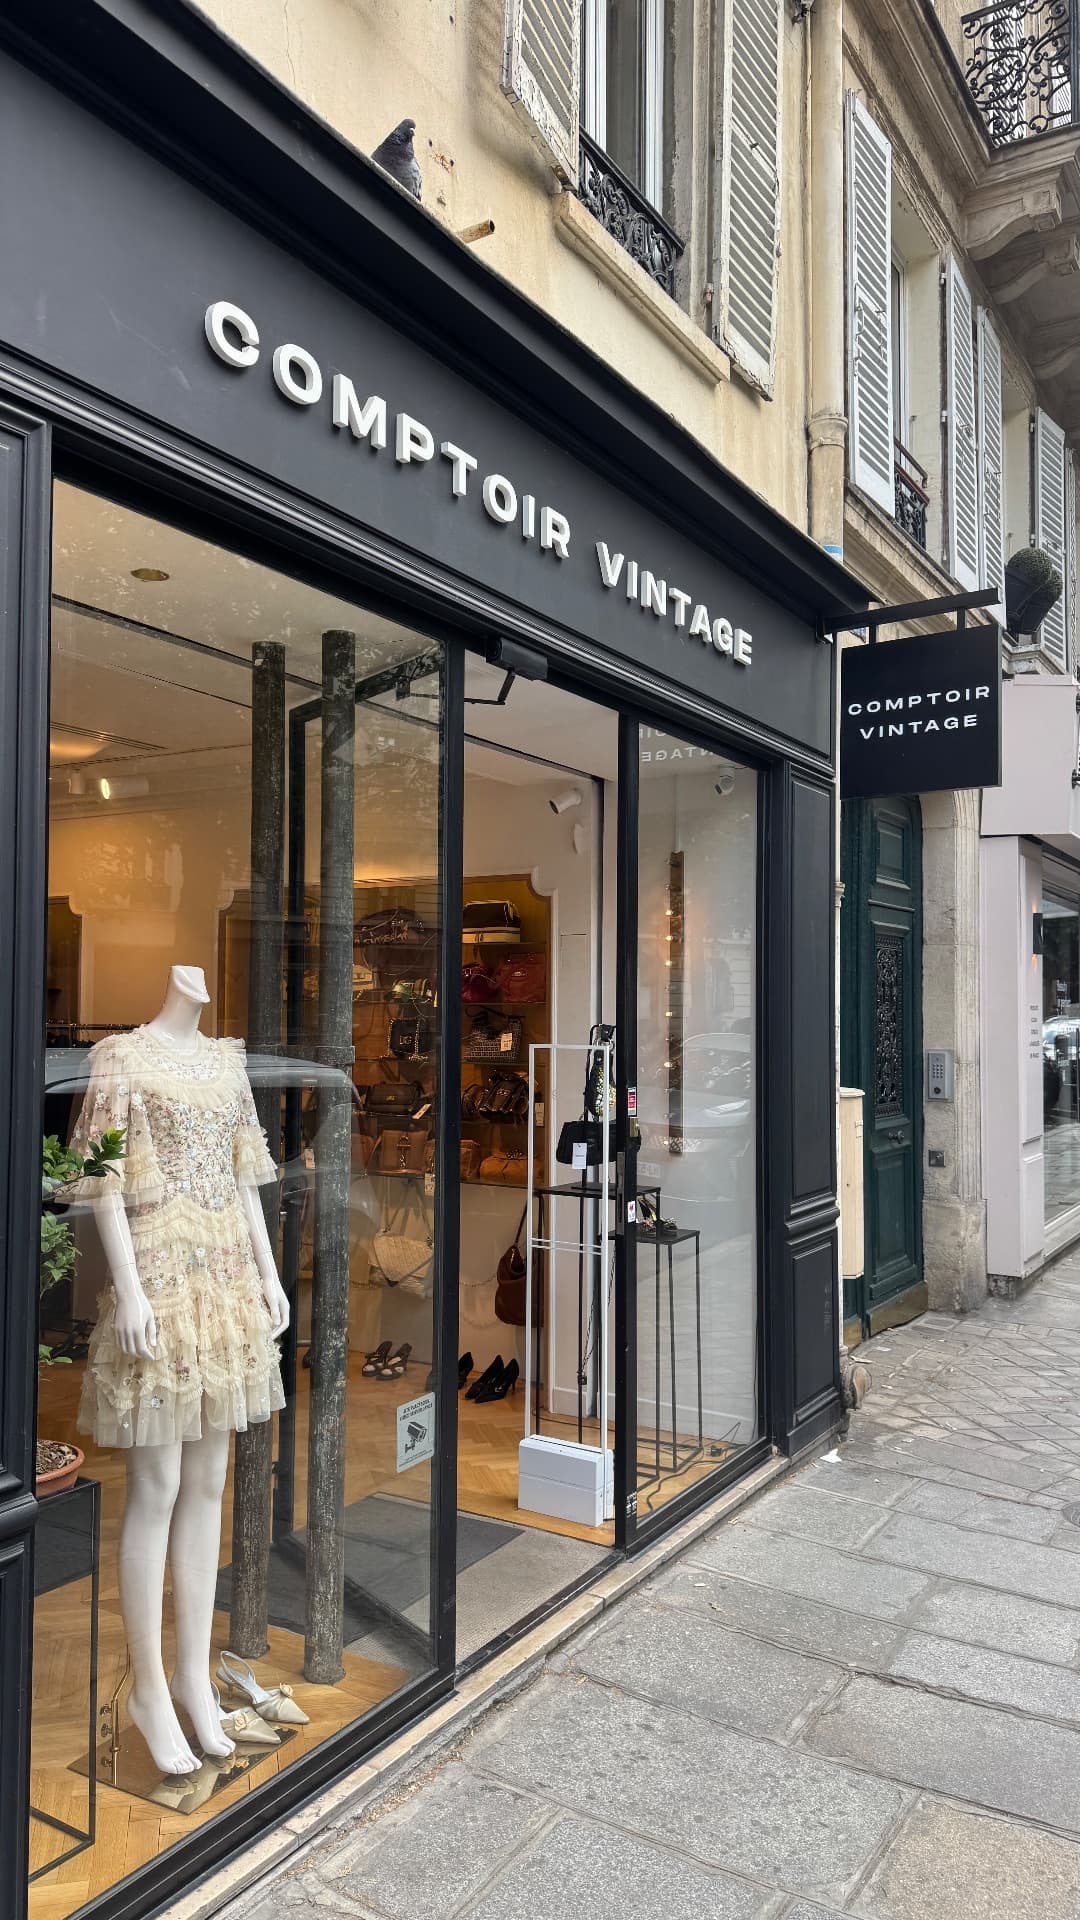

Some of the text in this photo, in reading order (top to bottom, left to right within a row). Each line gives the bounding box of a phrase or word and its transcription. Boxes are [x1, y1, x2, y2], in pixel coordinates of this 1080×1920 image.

[204, 300, 753, 666] COMPTOIR VINTAGE
[847, 685, 990, 716] COMPTOIR
[859, 714, 977, 740] VINTAGE
